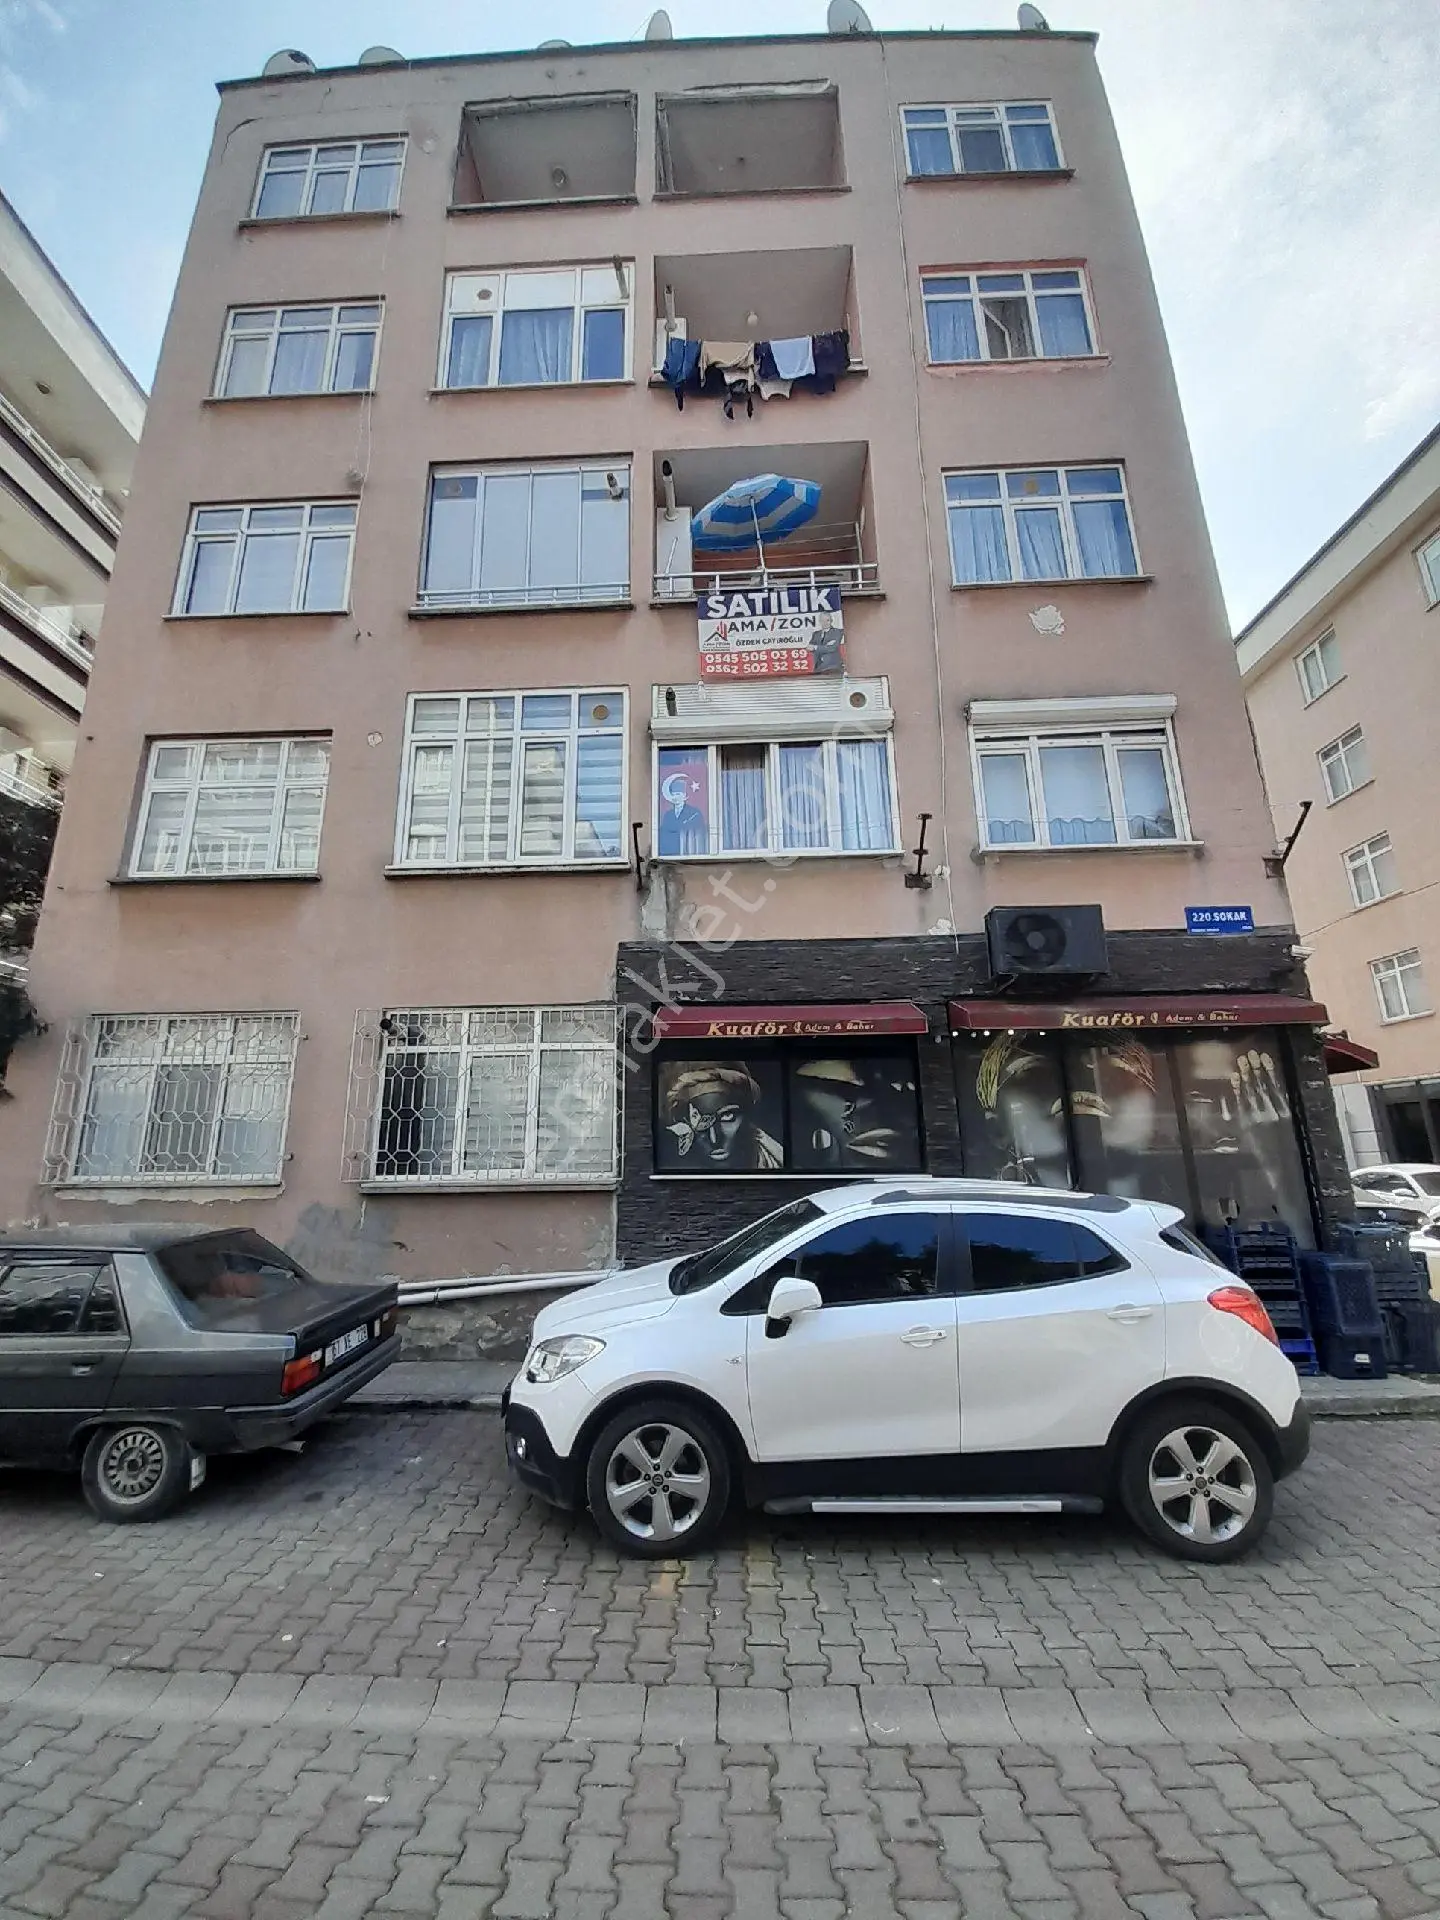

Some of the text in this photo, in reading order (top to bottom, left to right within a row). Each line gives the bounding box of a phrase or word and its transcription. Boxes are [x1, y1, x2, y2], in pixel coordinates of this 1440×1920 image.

[706, 588, 834, 619] SATILIK
[705, 649, 808, 664] 0545 506 03 69
[743, 662, 769, 674] 502
[771, 661, 789, 672] 32
[791, 660, 809, 670] 32
[1212, 911, 1247, 922] SOKAK
[1062, 1012, 1145, 1027] Kuaför
[708, 1021, 788, 1036] Kuaför
